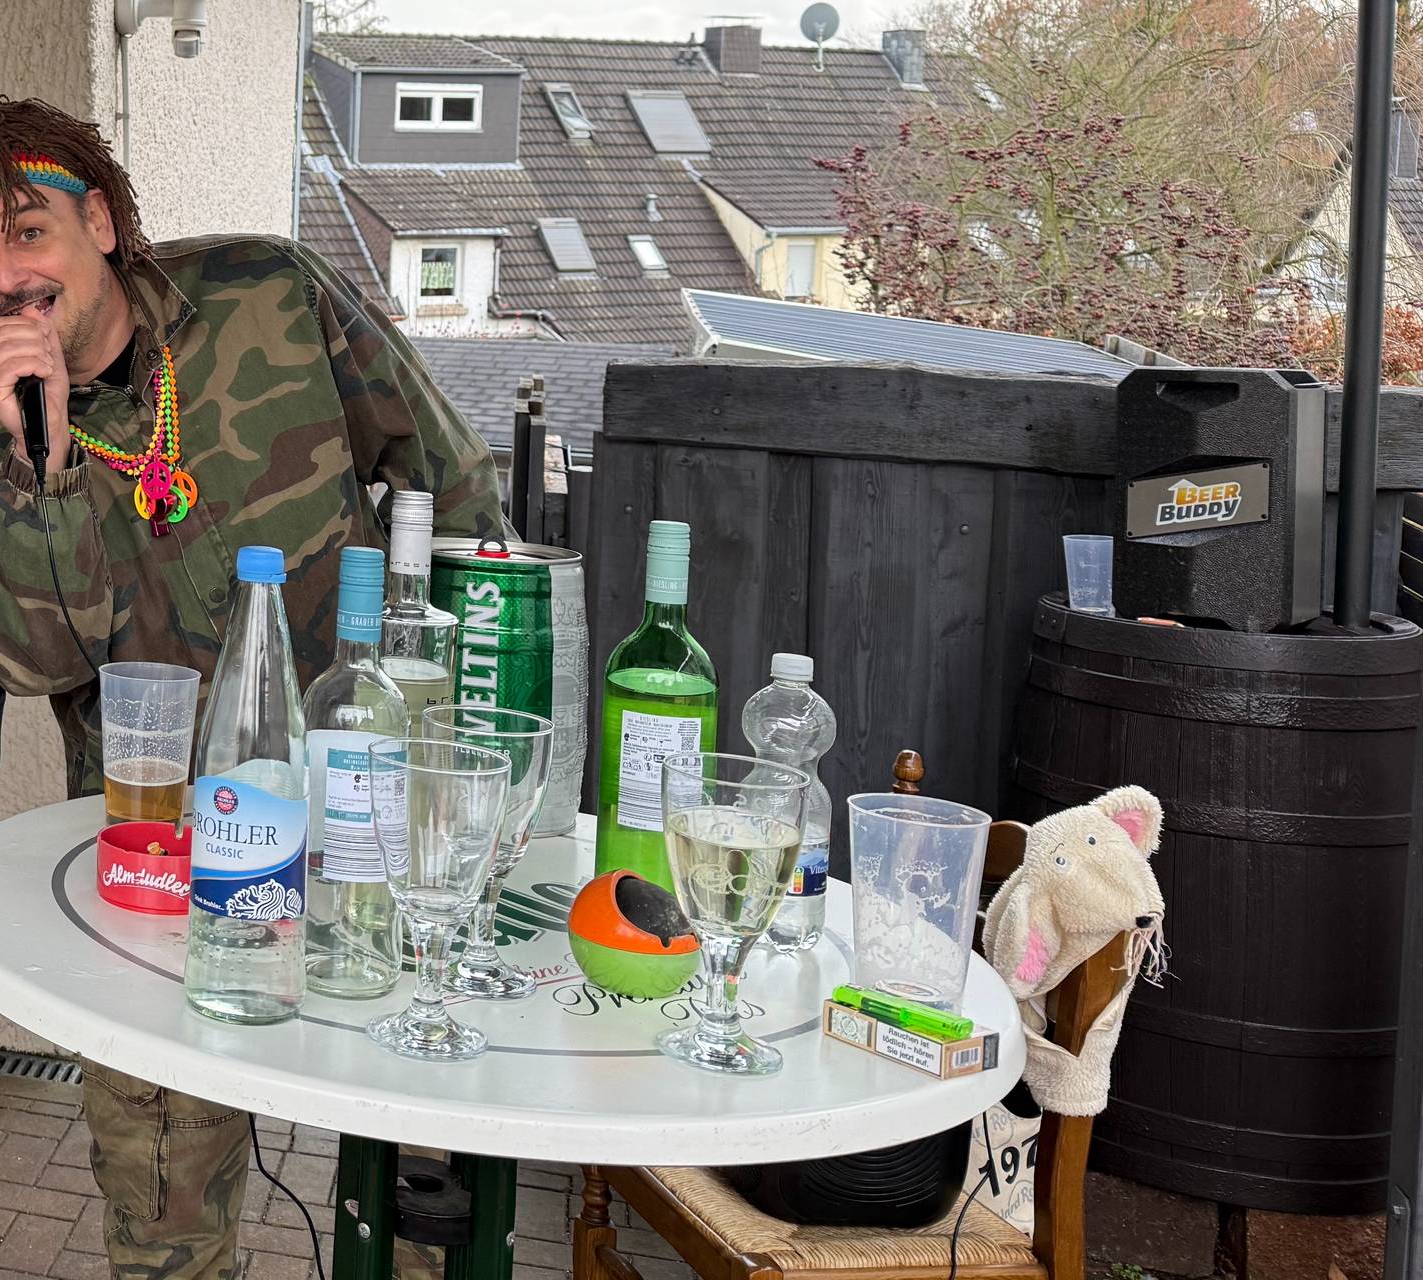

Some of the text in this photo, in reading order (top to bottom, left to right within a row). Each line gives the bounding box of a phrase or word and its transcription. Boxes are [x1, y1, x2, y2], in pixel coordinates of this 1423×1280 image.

[1176, 484, 1240, 505] BEER
[460, 581, 501, 738] VELTINS
[205, 842, 244, 860] CLASSIC
[882, 1034, 907, 1050] tödlich
[913, 1046, 934, 1060] hören
[888, 1027, 930, 1049] Rauchen ist
[886, 1045, 929, 1068] Sie jetzt auf.
